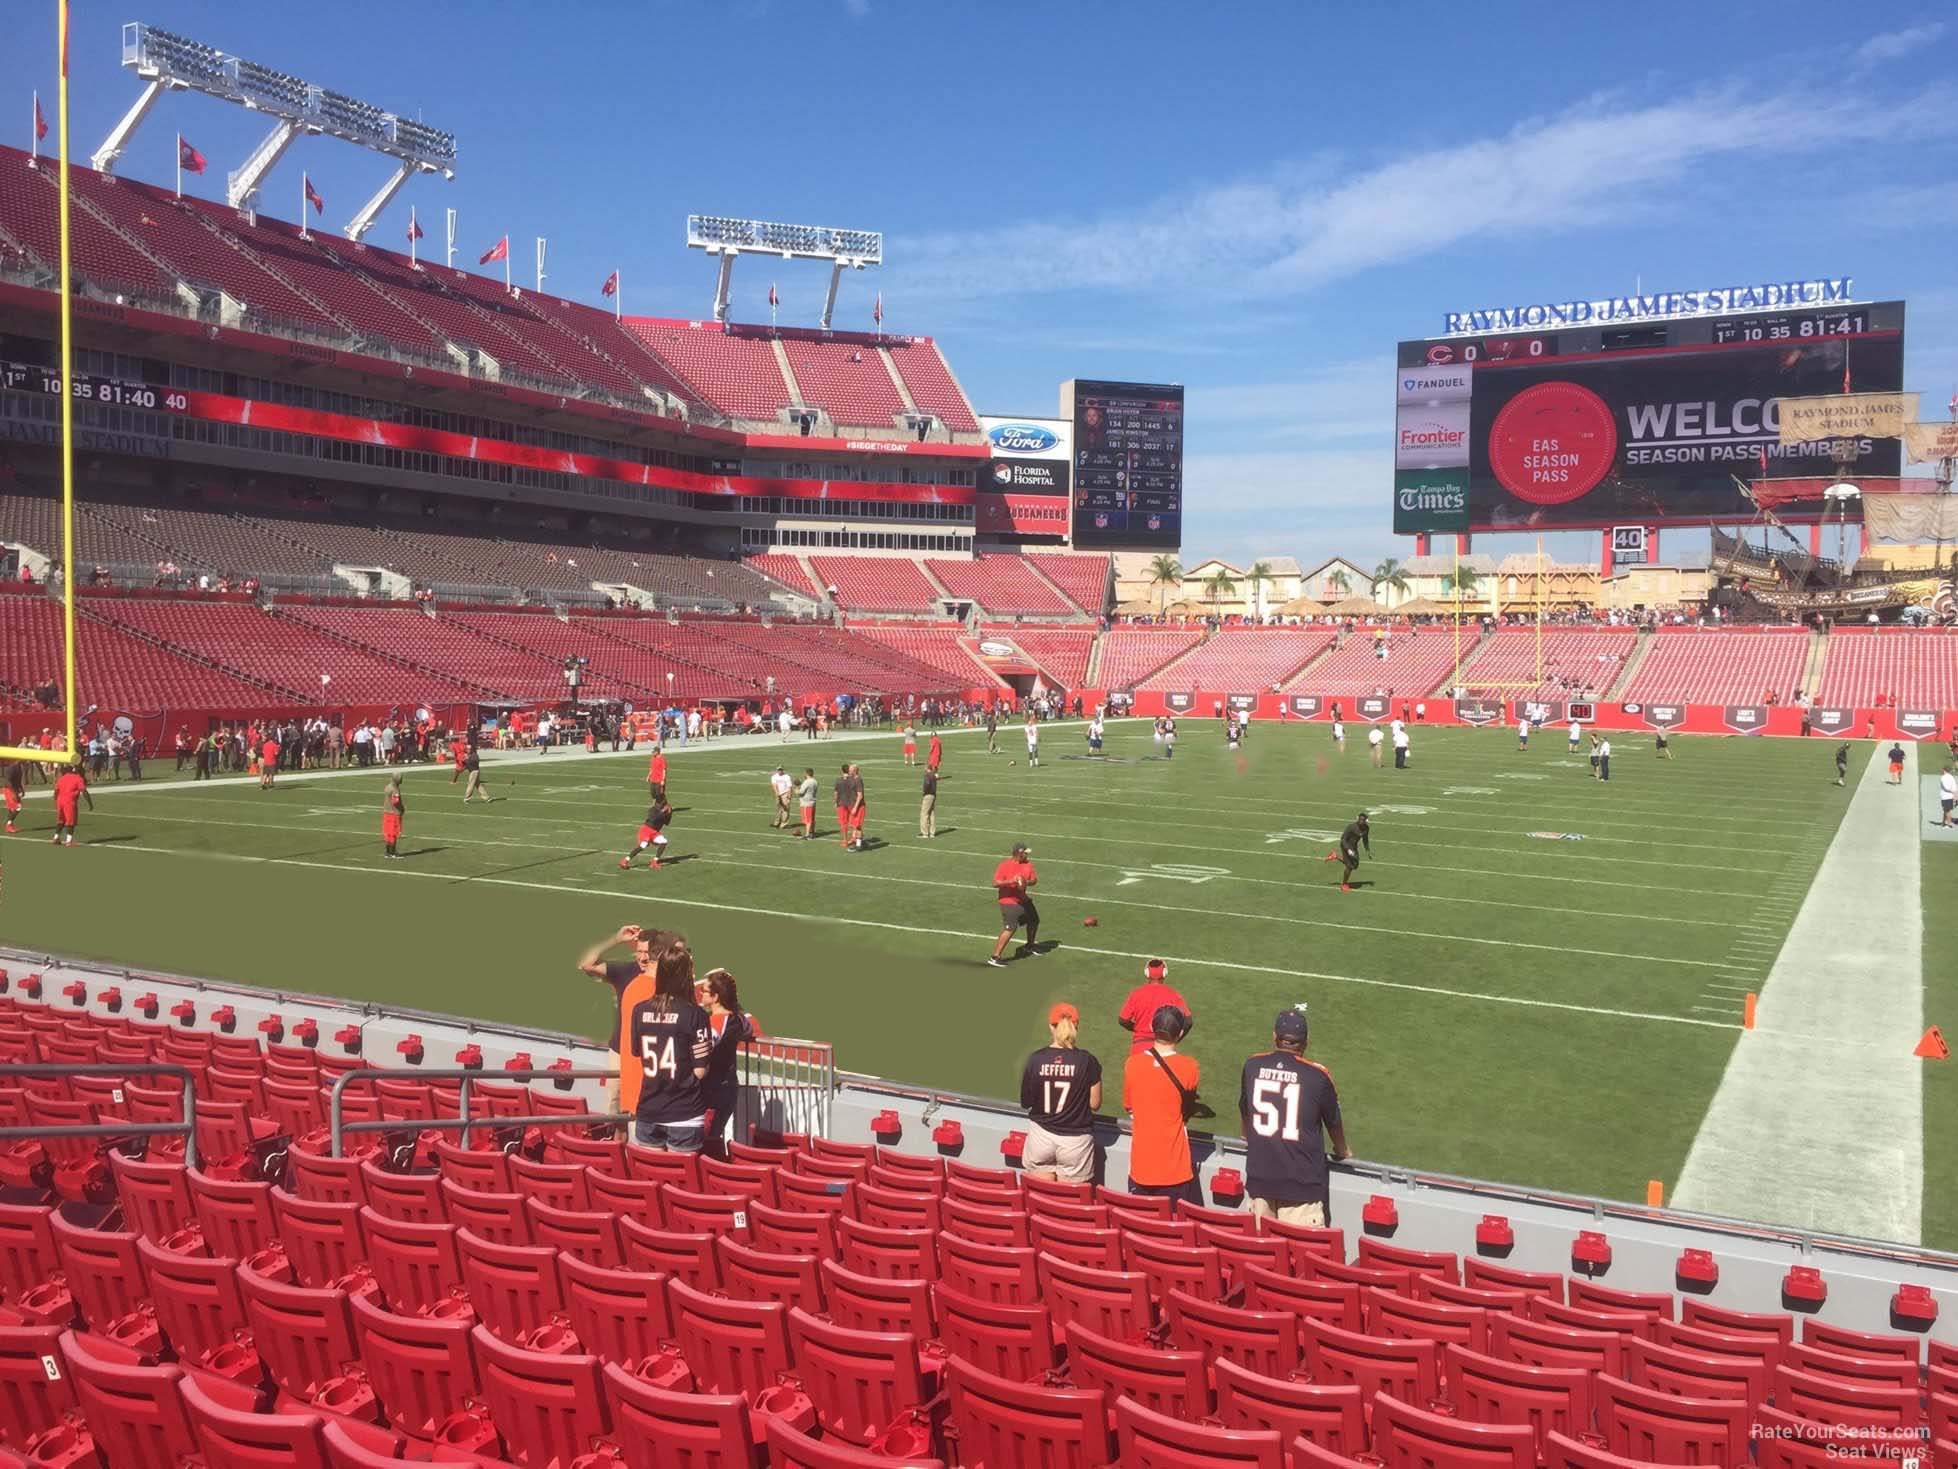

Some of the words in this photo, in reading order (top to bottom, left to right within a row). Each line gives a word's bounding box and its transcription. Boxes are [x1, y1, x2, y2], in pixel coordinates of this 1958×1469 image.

[1443, 300, 1593, 334] RAYMOND
[1597, 291, 1697, 320] JAMES
[1706, 276, 1852, 310] STADIUM
[1717, 330, 1736, 343] 1ST
[1744, 328, 1762, 341] 10
[1769, 326, 1790, 339] 35
[1800, 317, 1862, 337] 81:41
[7, 371, 26, 386] 1ST
[42, 378, 61, 393] 10
[72, 383, 92, 398] 35
[99, 384, 155, 408] 81:40
[165, 393, 186, 410] 40
[1417, 378, 1465, 389] FANDUEL
[1626, 399, 1780, 439] WELCO
[1792, 405, 1861, 420] RAYMOND
[1863, 403, 1905, 416] JAMES
[1819, 417, 1874, 429] STADIUM
[999, 427, 1045, 449] Ford
[1401, 429, 1465, 444] Frontier
[846, 441, 908, 452] #SIEGETHEDAY
[1532, 440, 1559, 452] EAS
[1626, 447, 1708, 465] SEASON
[1710, 446, 1760, 461] PASS
[1767, 438, 1873, 459] MEMBERS
[1523, 454, 1579, 468] SEASON
[1014, 465, 1050, 476] FLORIDA
[1532, 470, 1569, 483] PASS
[1014, 475, 1055, 486] HOSPITAL
[1400, 486, 1464, 511] Times
[1009, 507, 1067, 521] BUCCANEERS
[1615, 531, 1642, 546] 40
[641, 1035, 677, 1080] 54
[1039, 1064, 1075, 1077] JEFFERY
[1259, 1067, 1298, 1083] BUTKUS
[1044, 1081, 1071, 1114] 17
[1253, 1079, 1301, 1141] 51
[46, 1359, 57, 1376] 3
